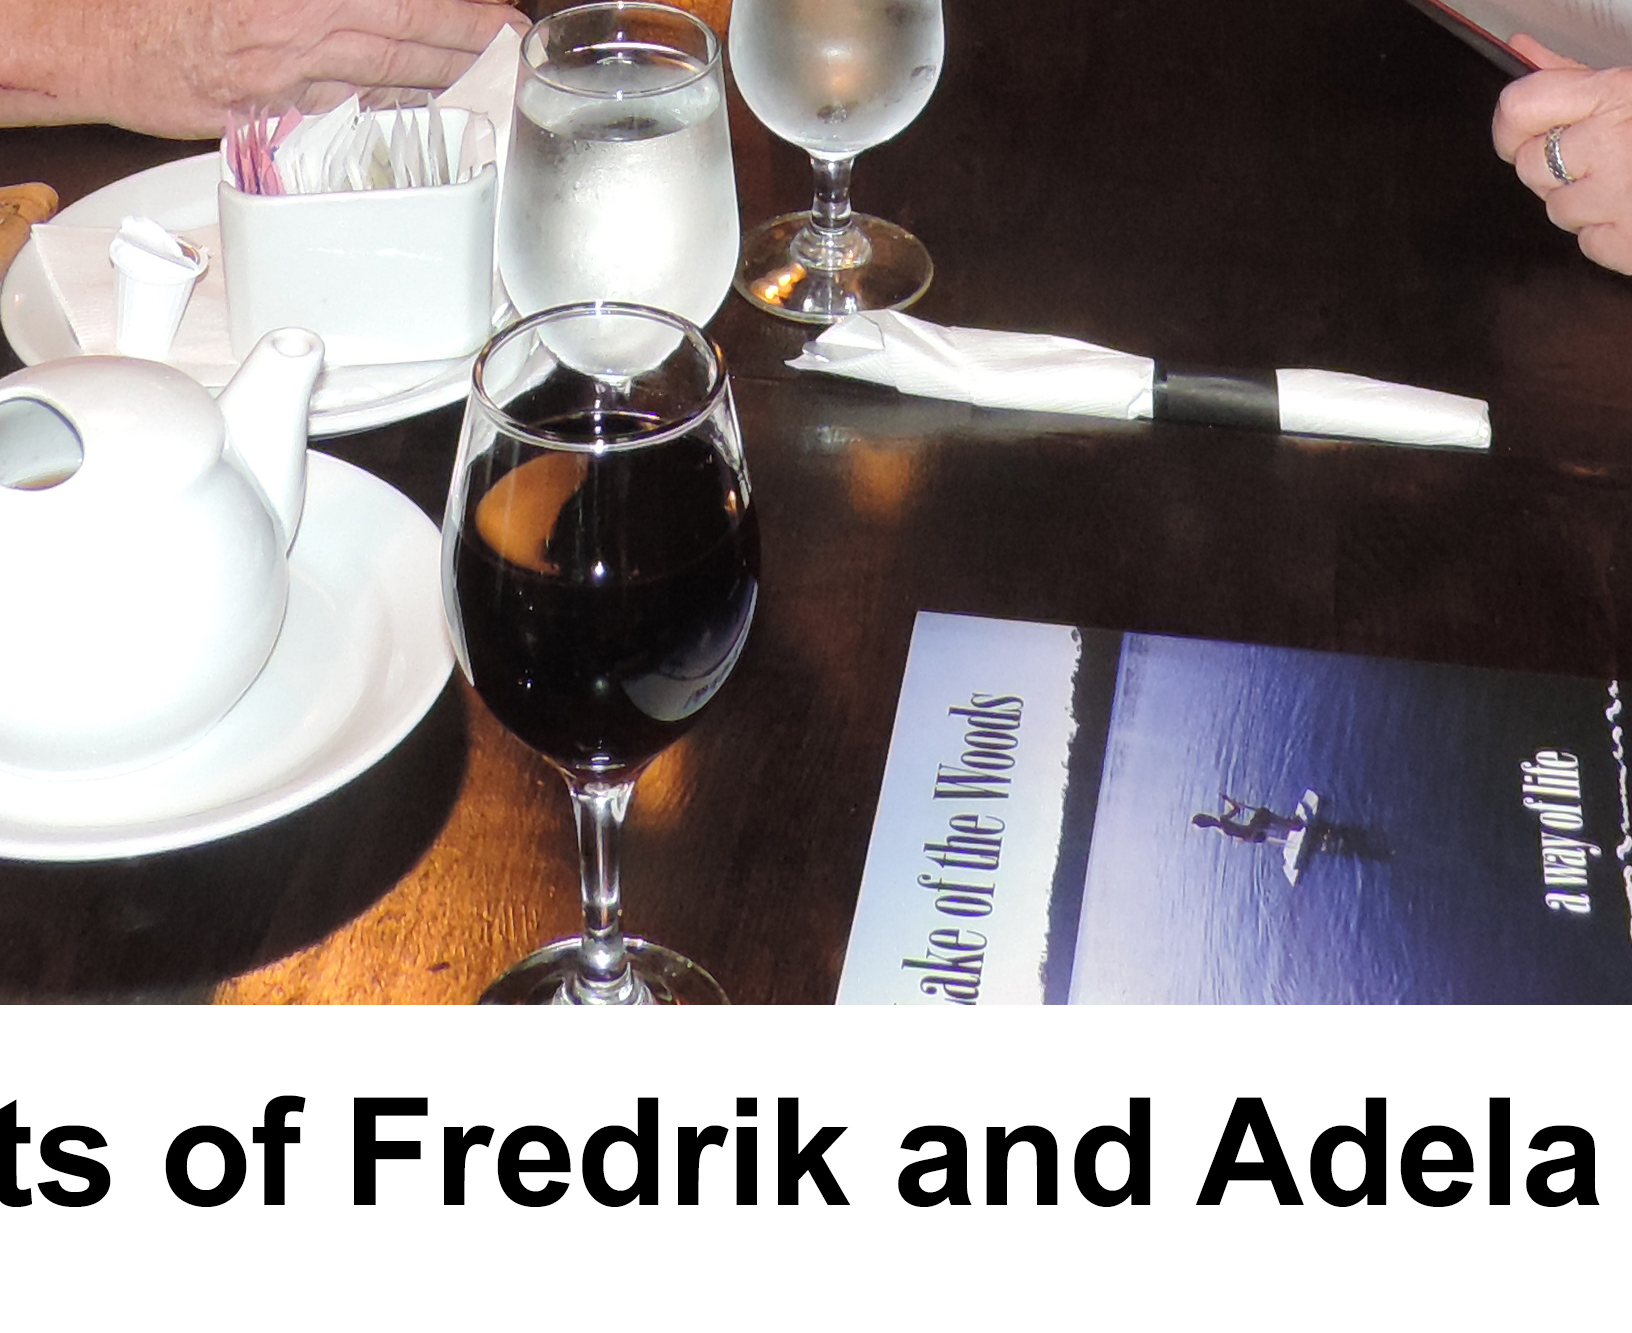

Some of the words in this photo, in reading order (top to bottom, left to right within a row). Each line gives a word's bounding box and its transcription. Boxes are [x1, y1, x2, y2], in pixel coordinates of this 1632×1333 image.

[933, 692, 1024, 800] Woods
[1520, 750, 1581, 798] life
[1523, 796, 1583, 830] of
[923, 813, 1006, 871] the
[1541, 831, 1602, 885] way
[917, 874, 996, 917] of
[1545, 892, 1591, 914] a
[899, 928, 988, 1005] ake
